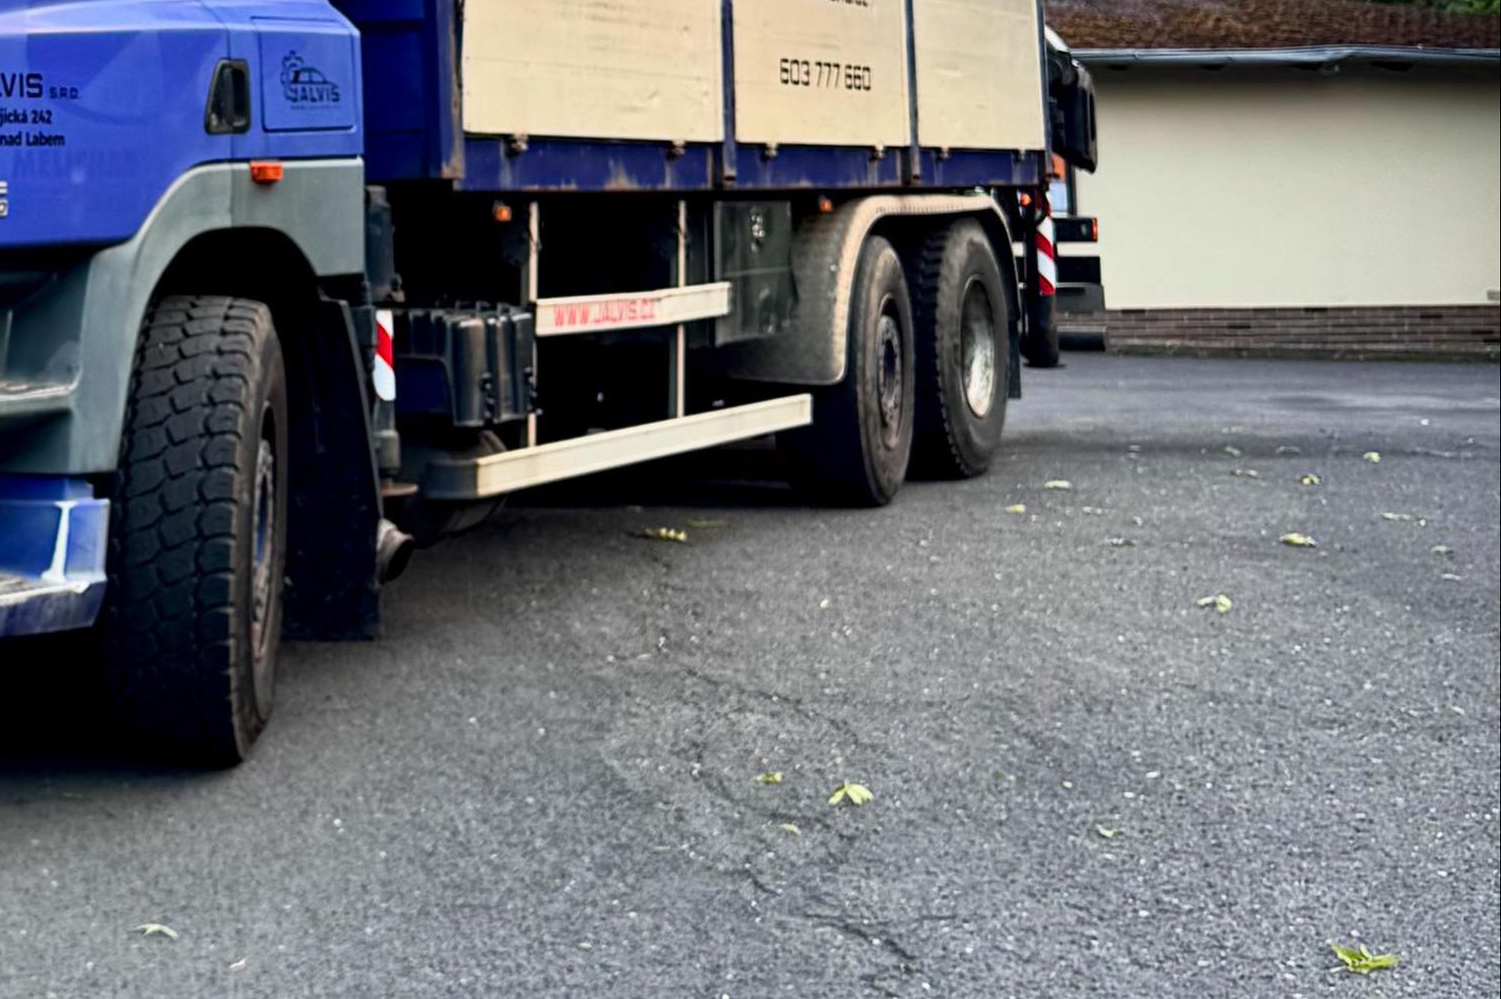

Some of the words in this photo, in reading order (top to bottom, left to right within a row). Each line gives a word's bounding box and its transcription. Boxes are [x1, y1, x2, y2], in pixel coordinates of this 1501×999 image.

[780, 58, 810, 87] 603
[815, 61, 840, 88] 777
[844, 64, 871, 91] 660
[31, 109, 53, 125] 242
[25, 130, 66, 147] Labem
